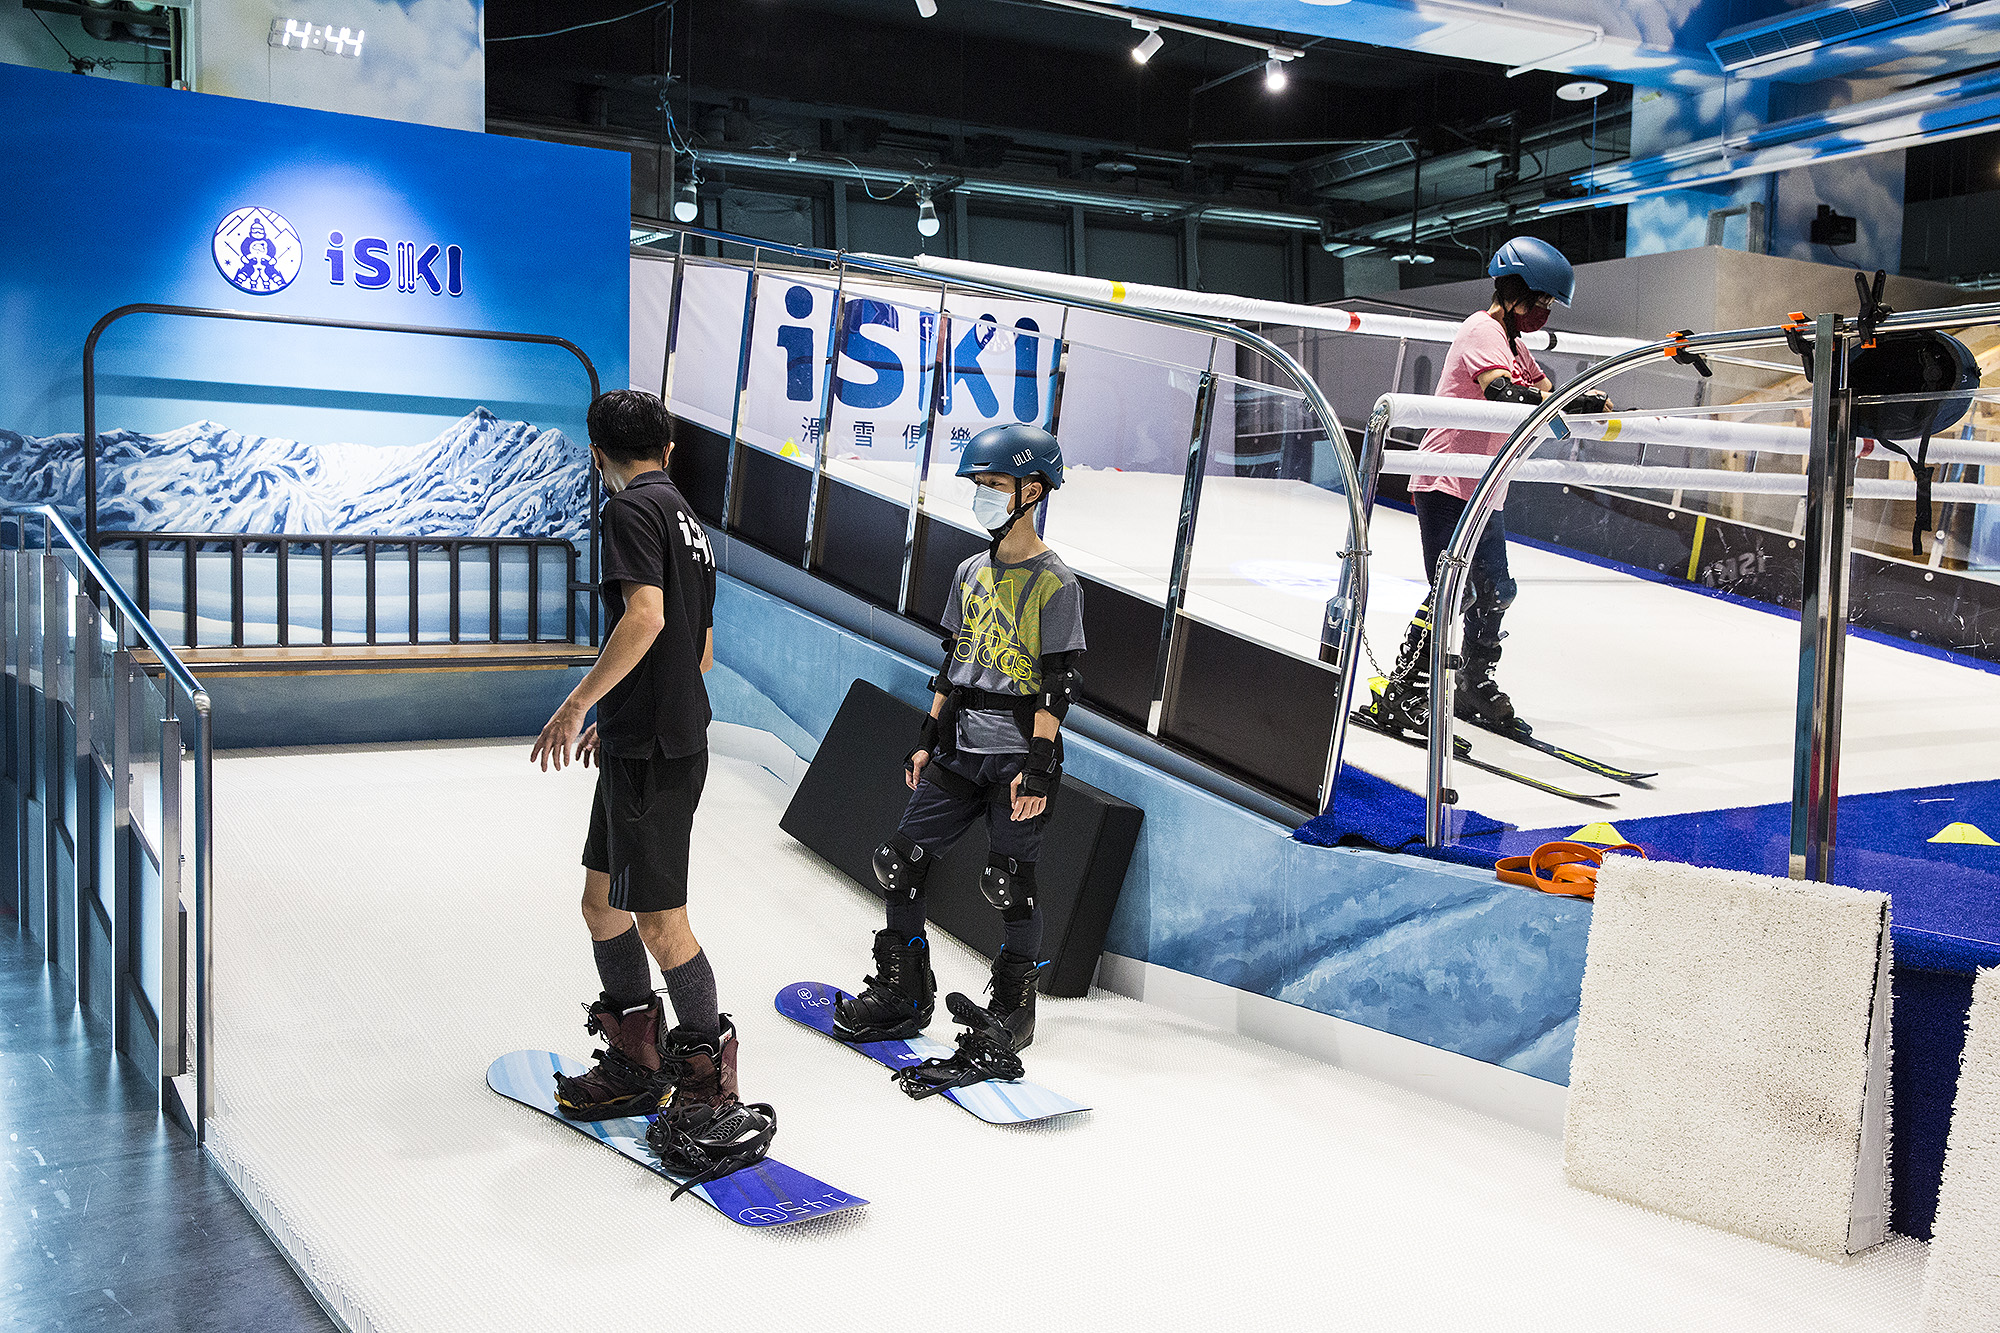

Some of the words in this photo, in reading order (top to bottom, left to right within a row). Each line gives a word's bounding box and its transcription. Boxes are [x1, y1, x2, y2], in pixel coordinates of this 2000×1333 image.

[282, 19, 365, 57] 14:44
[324, 229, 463, 298] iSKI
[777, 285, 1040, 424] iSKI
[1012, 448, 1034, 467] ULLR
